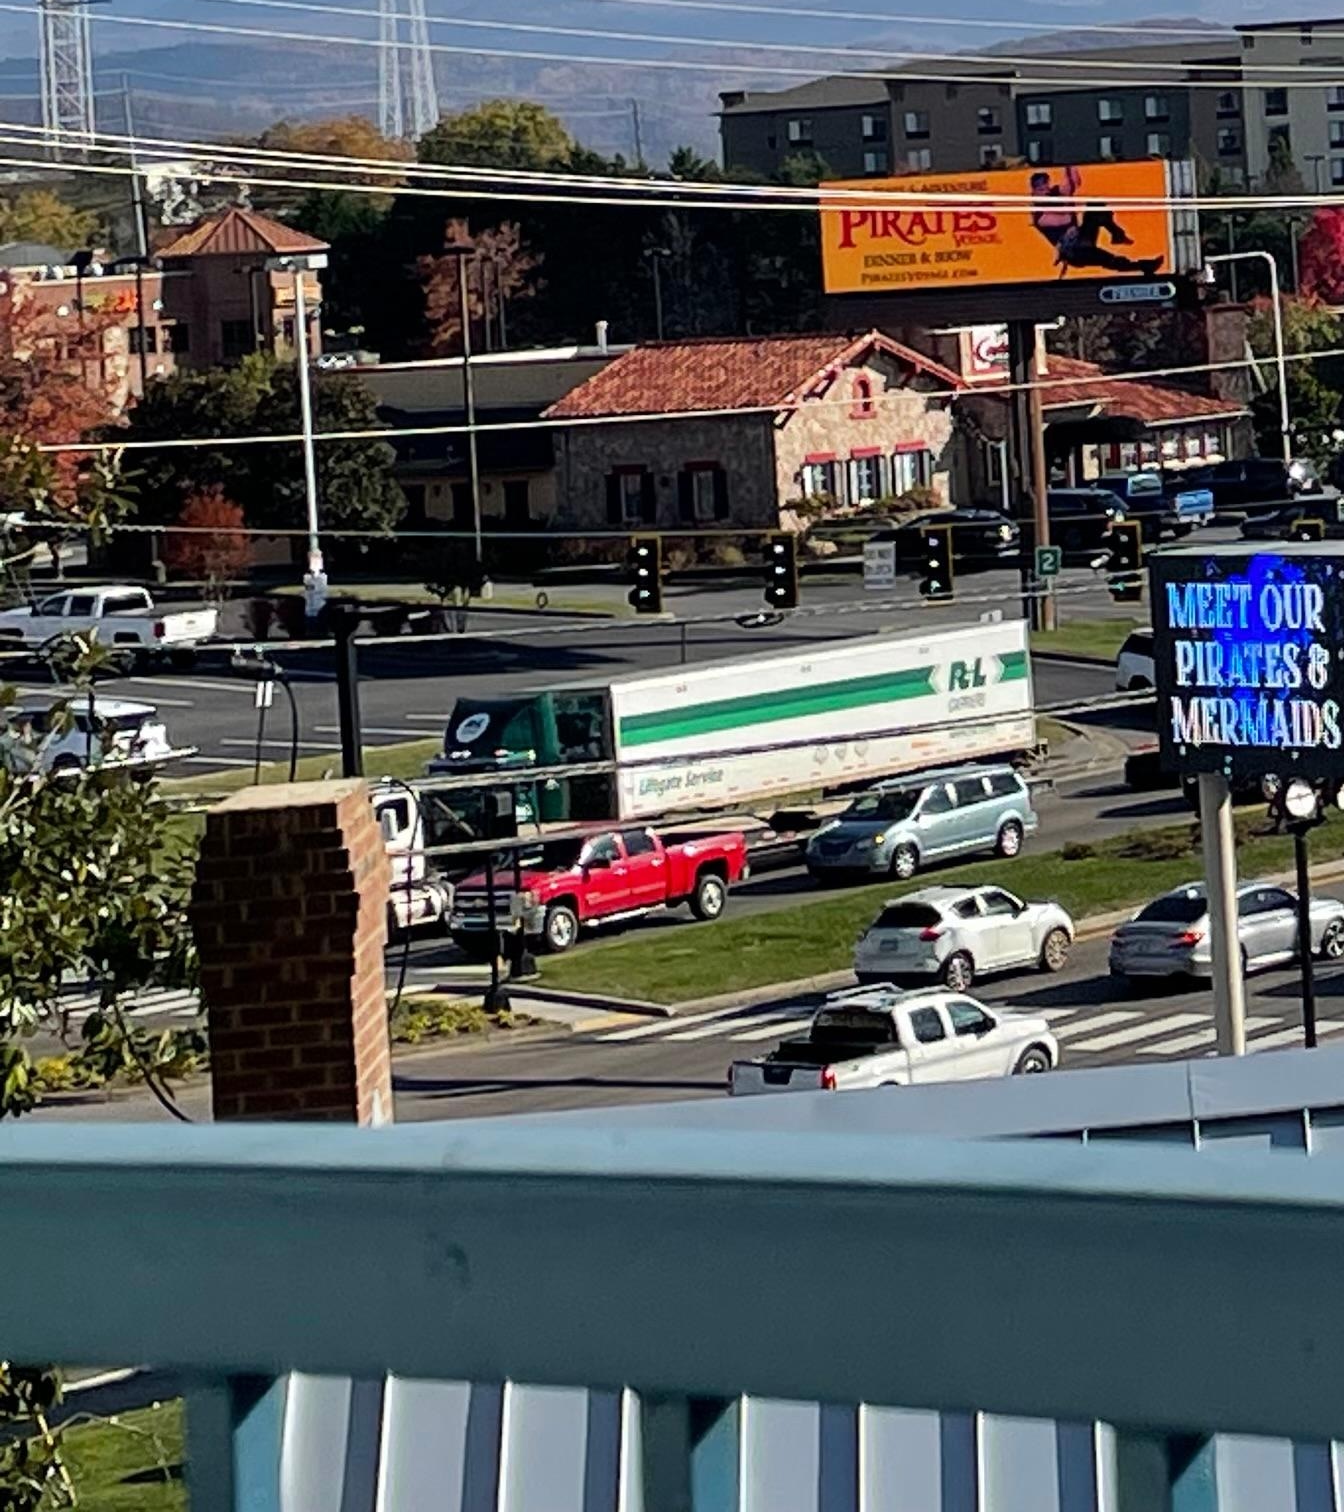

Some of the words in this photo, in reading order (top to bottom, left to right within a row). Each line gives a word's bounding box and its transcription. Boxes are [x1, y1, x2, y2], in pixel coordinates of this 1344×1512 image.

[838, 206, 998, 249] PIRATES
[863, 253, 917, 269] DINNER
[1041, 553, 1055, 571] 2
[1165, 582, 1252, 629] MEET
[1259, 583, 1326, 632] OUR
[1174, 640, 1301, 688] PIRATES
[1307, 643, 1330, 690] &
[1171, 695, 1342, 749] MERMAIDS
